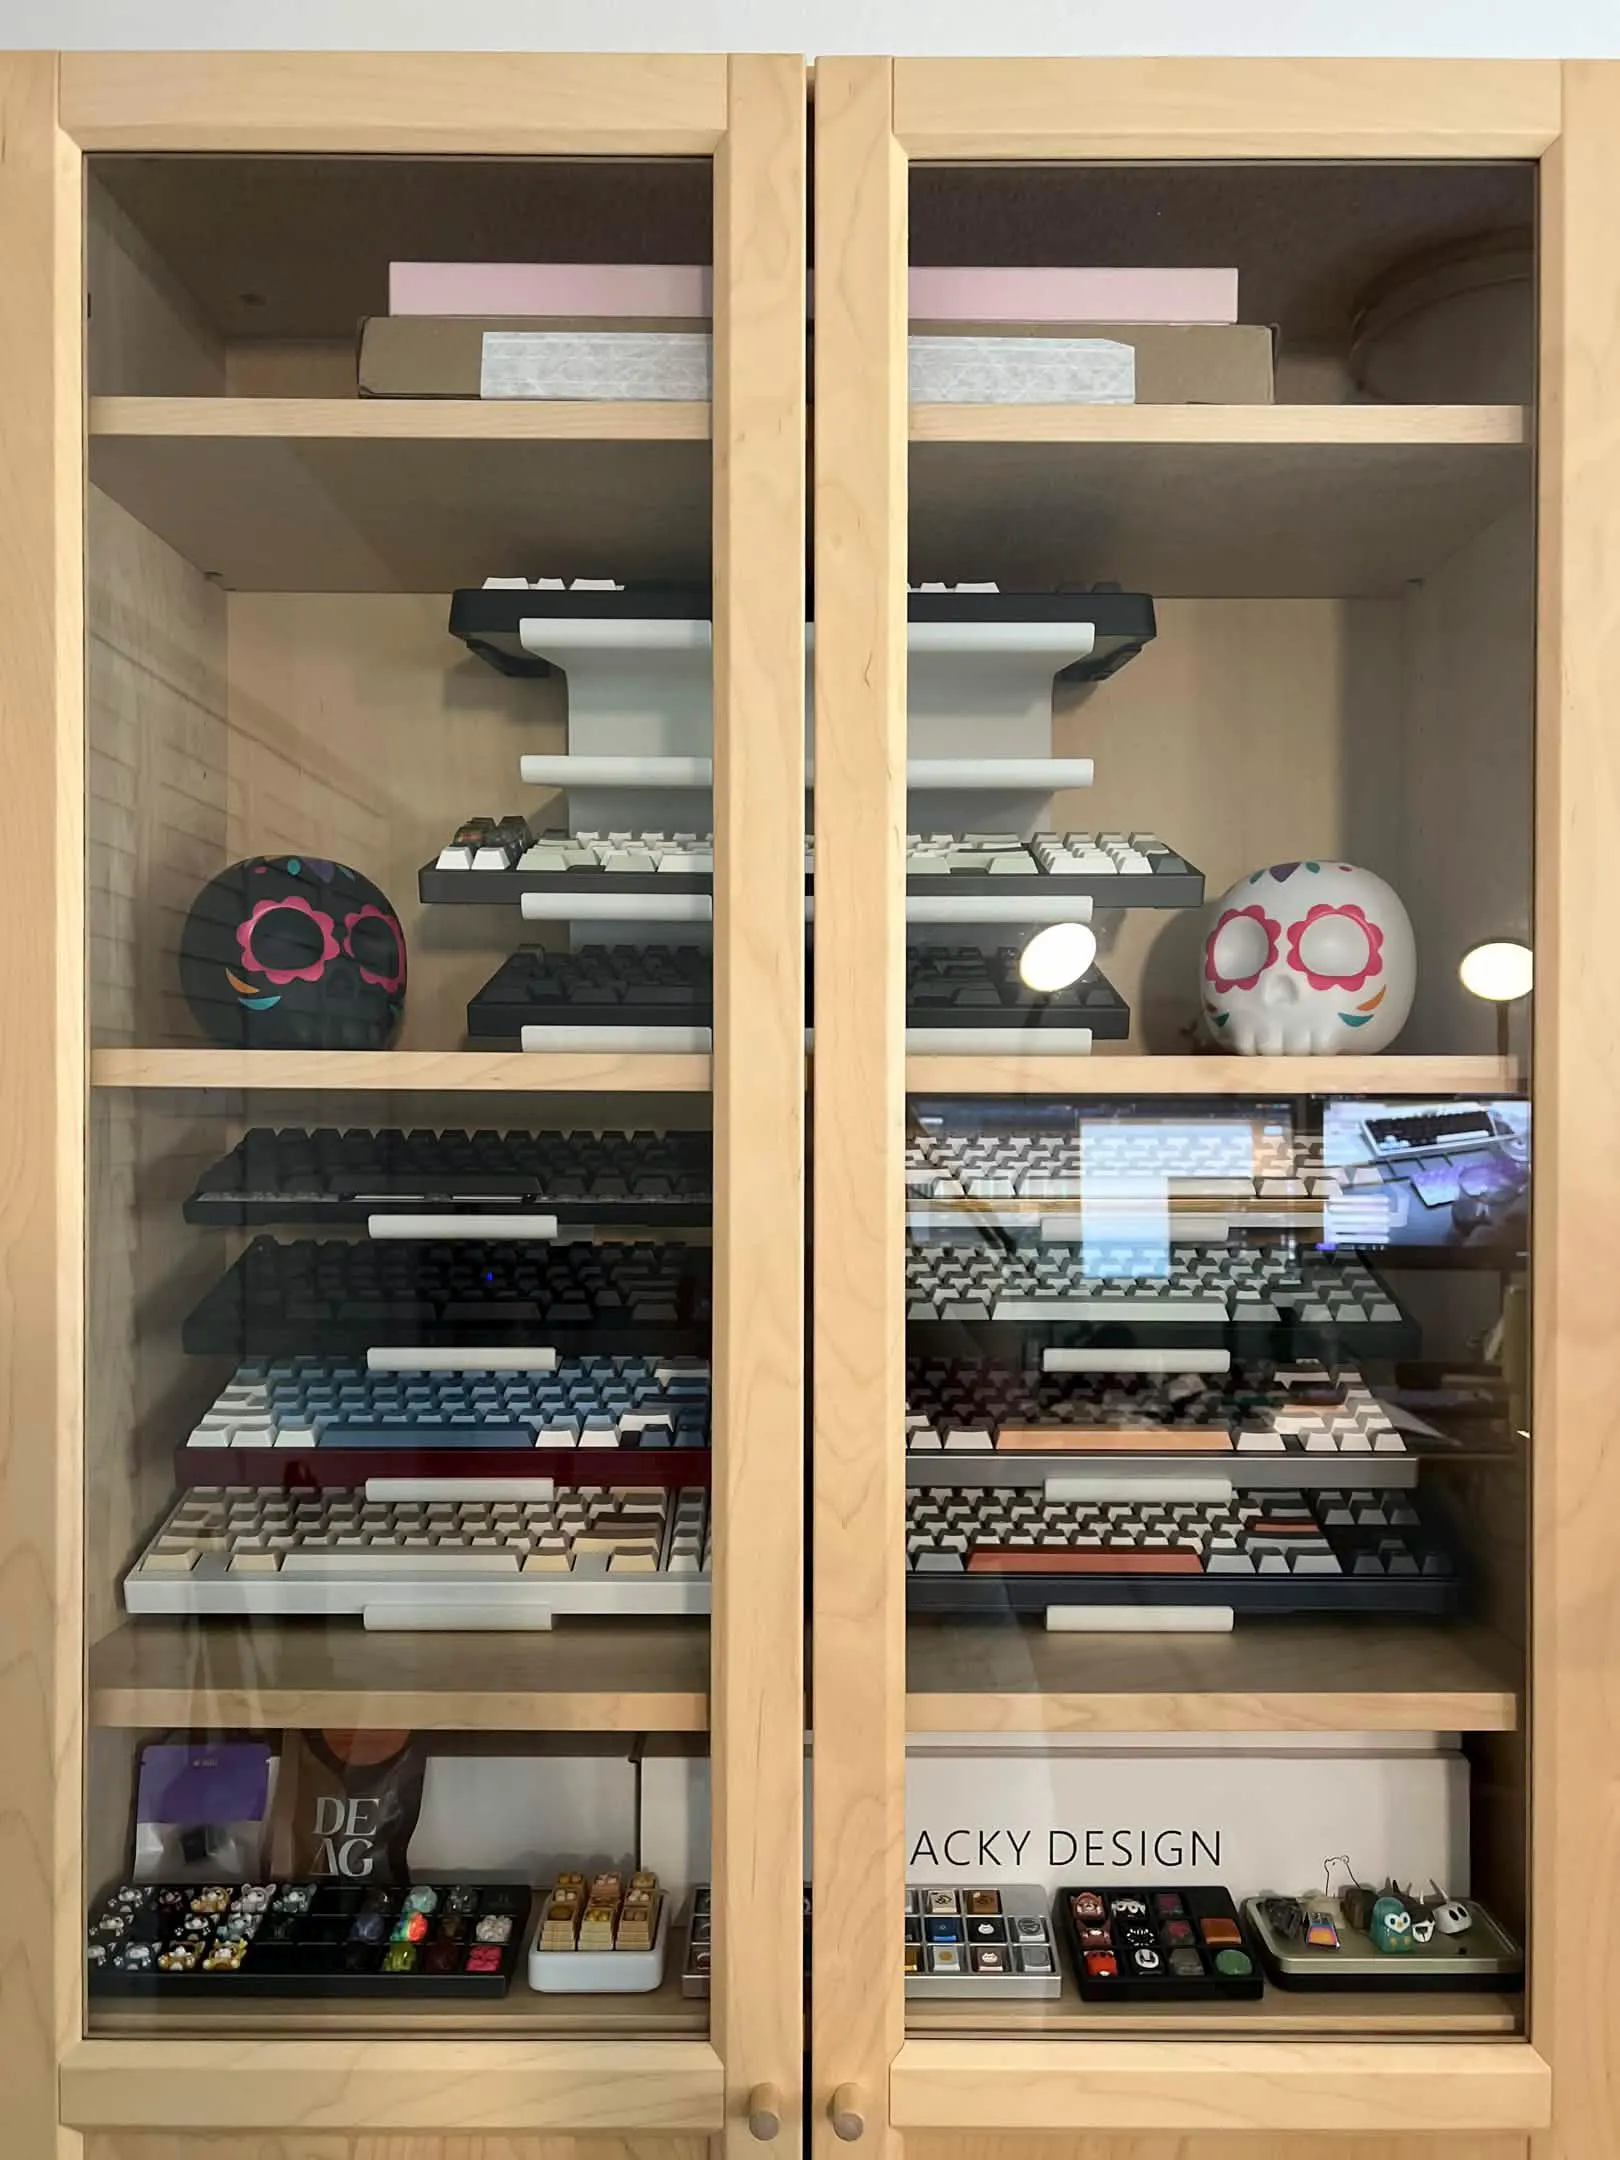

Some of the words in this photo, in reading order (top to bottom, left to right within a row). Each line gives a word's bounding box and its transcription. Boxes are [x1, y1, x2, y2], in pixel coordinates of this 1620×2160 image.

[311, 1796, 380, 1836] DE
[909, 1829, 1031, 1866] ACKY
[1049, 1829, 1220, 1866] DESIGN
